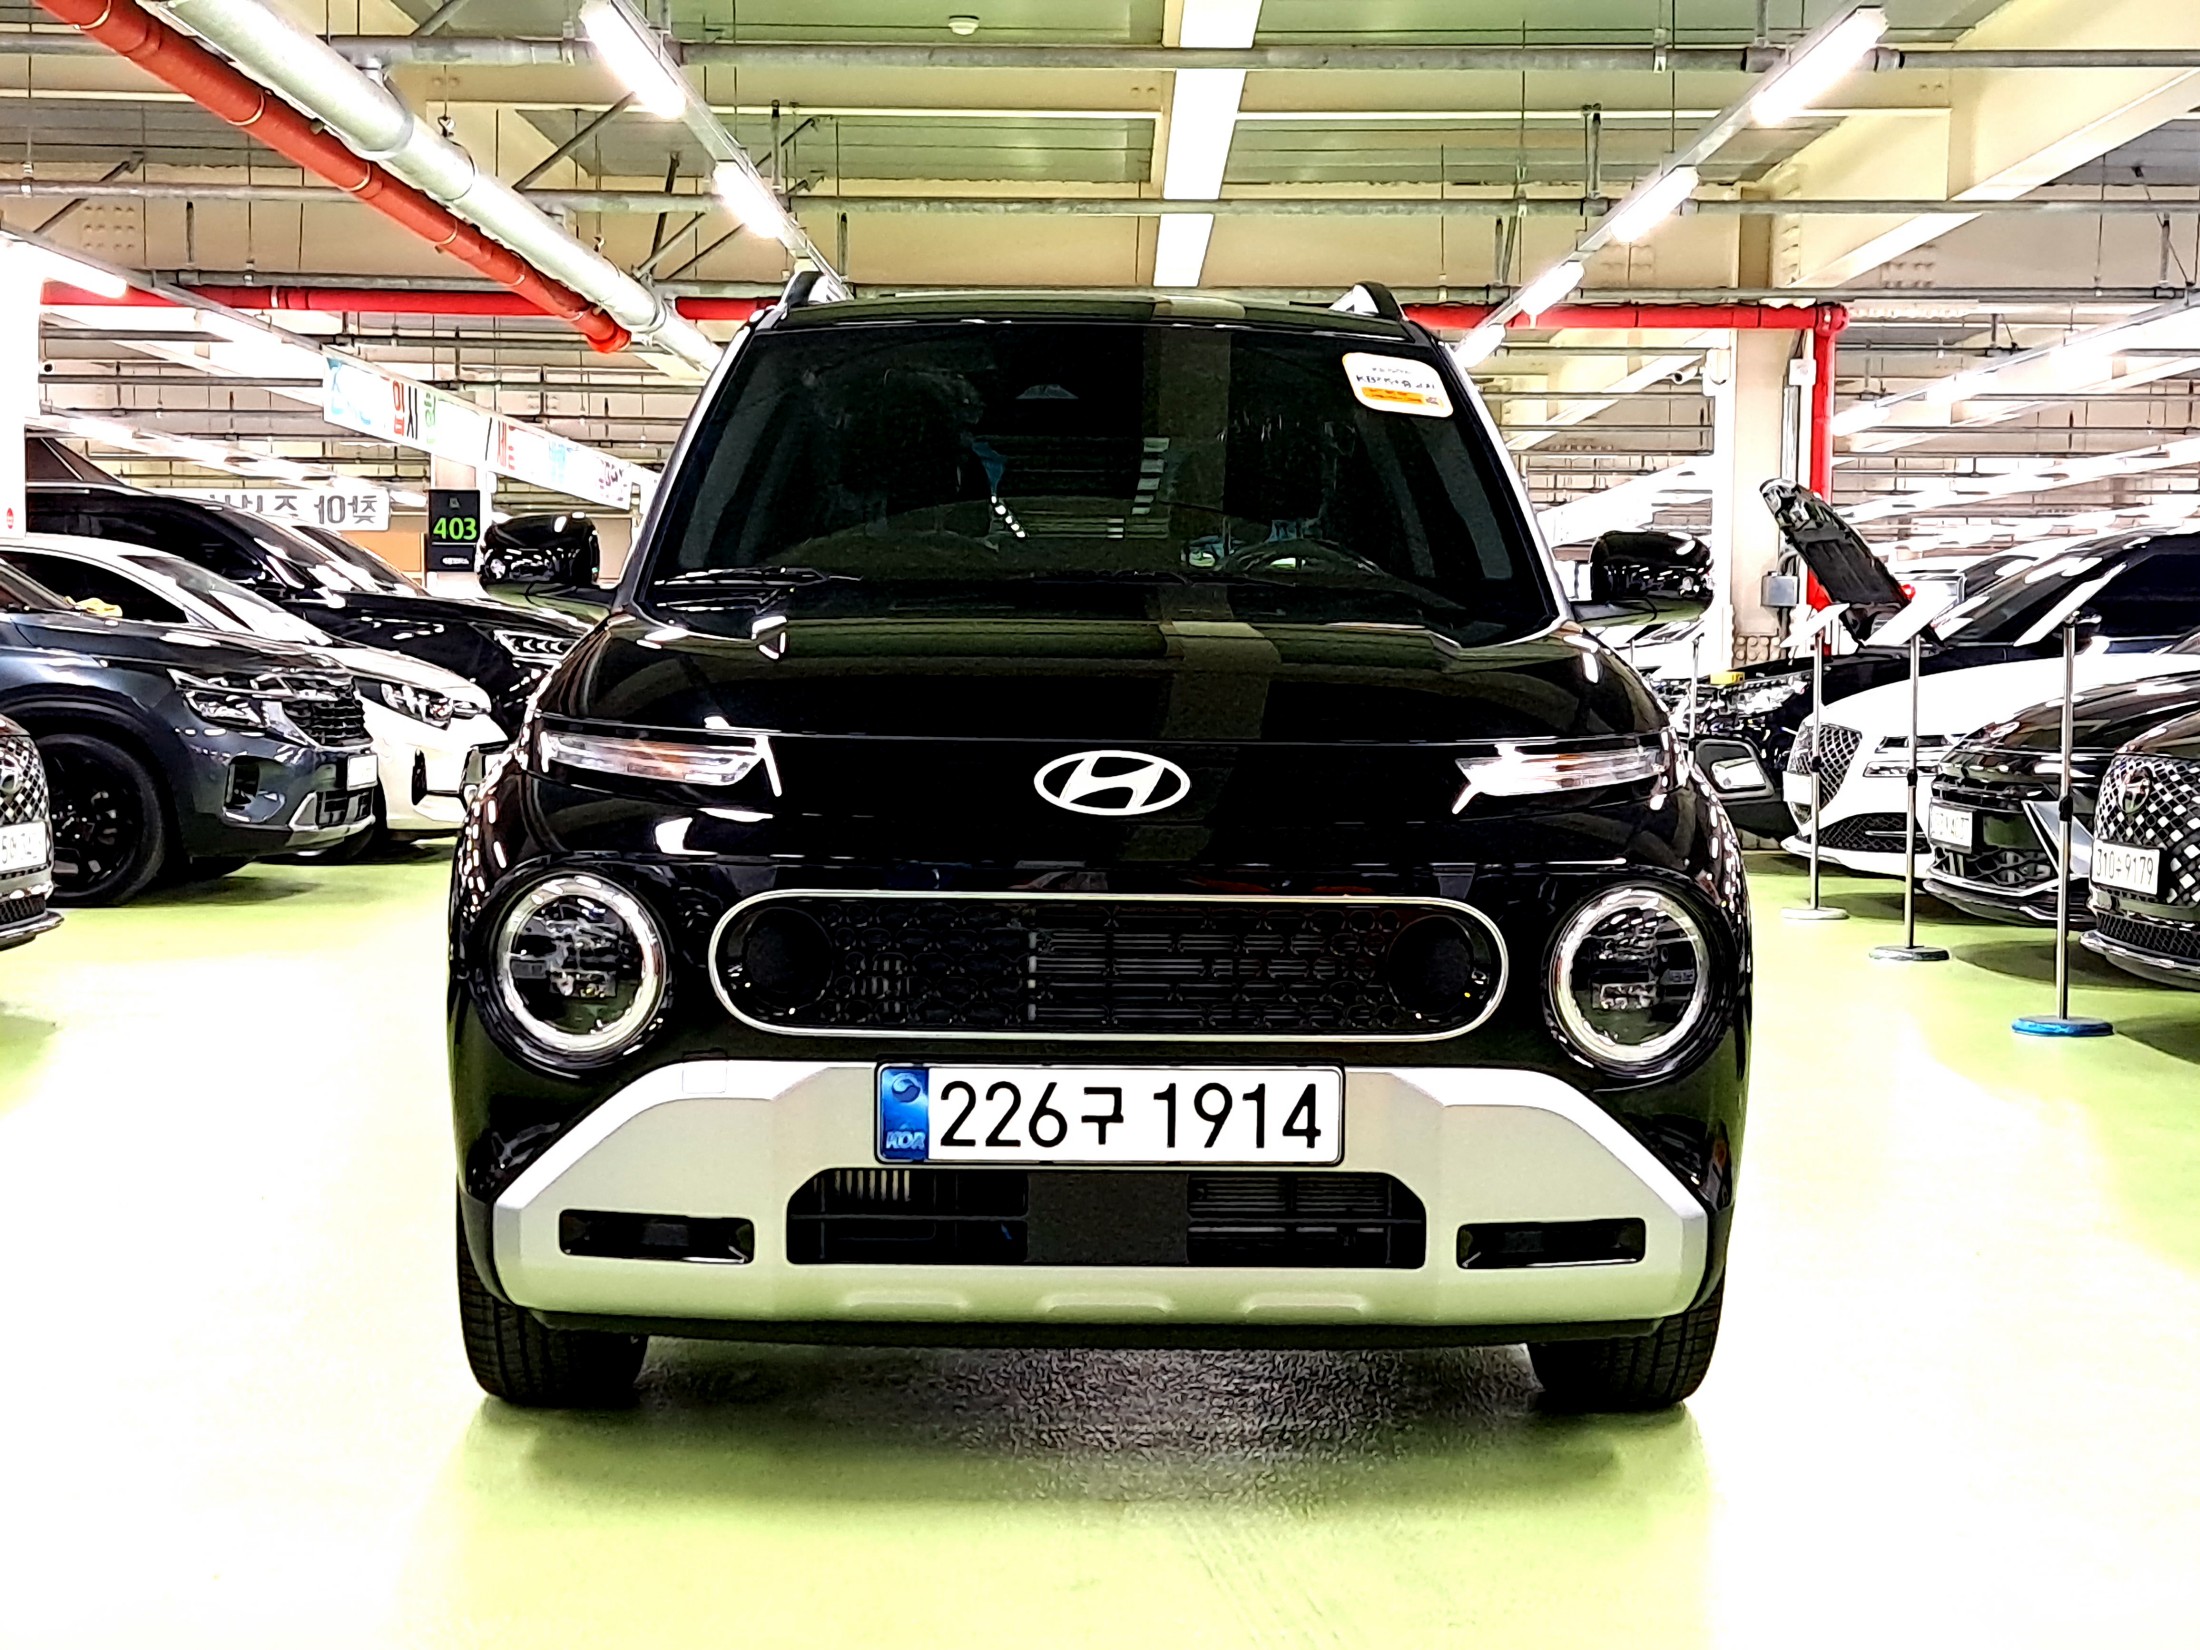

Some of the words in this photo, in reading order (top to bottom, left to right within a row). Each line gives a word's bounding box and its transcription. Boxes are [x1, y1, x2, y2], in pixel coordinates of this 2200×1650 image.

[433, 517, 478, 541] 403
[940, 1080, 1124, 1148] 226구
[1153, 1082, 1322, 1149] 1914
[886, 1131, 926, 1150] KOR
